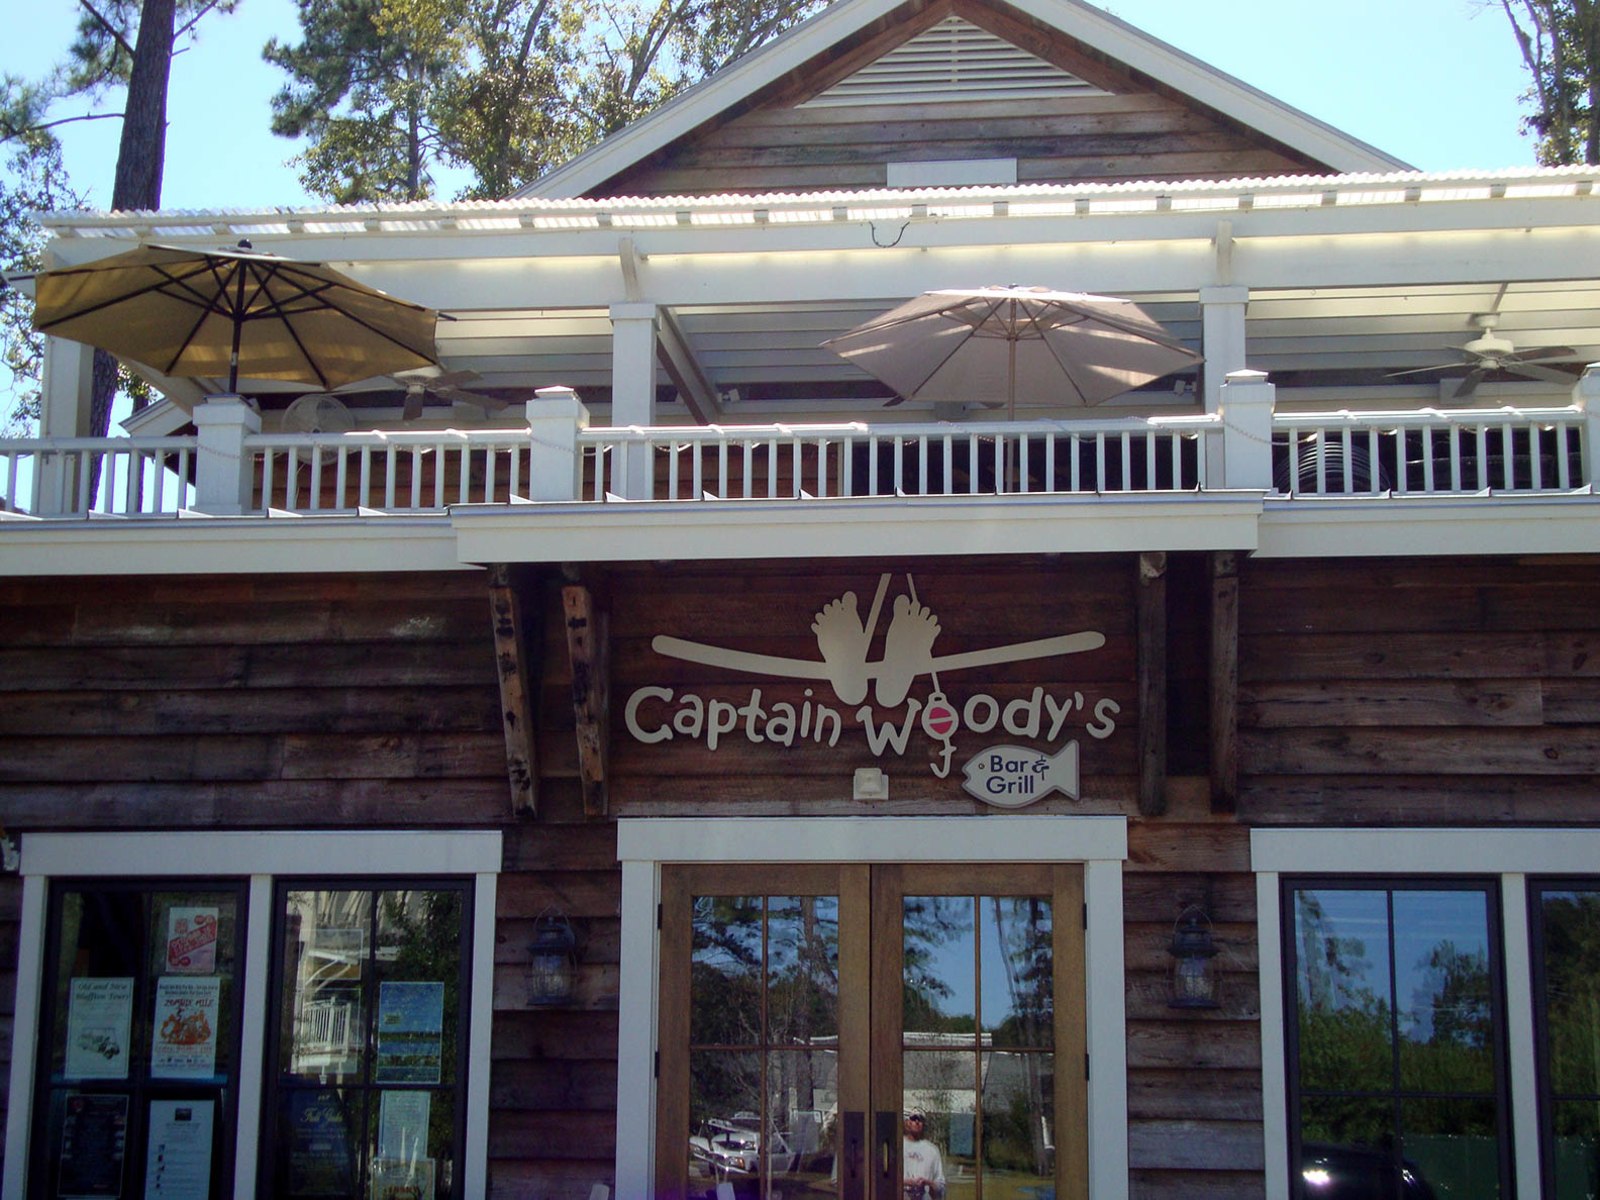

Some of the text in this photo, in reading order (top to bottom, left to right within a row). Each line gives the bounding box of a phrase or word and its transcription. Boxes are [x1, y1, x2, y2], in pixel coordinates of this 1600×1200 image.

[625, 686, 1121, 758] Captain Woody's
[990, 755, 1028, 774] Bar
[986, 775, 1034, 795] Grill
